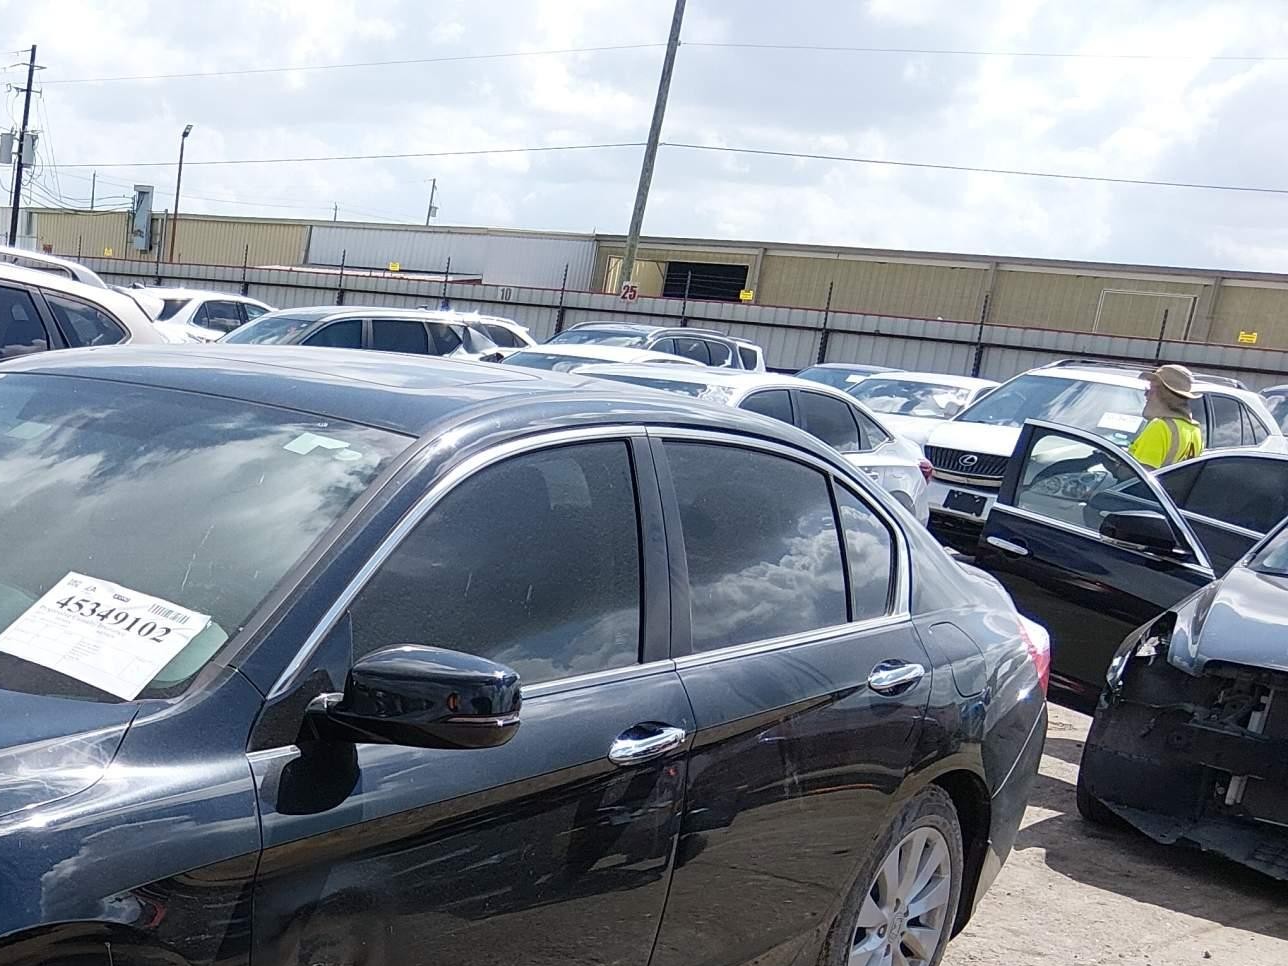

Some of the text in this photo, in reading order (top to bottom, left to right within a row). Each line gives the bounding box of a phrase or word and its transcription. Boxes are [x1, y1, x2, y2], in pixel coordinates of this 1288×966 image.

[500, 287, 512, 301] 10
[620, 285, 638, 300] 25
[56, 595, 172, 643] 45349102
